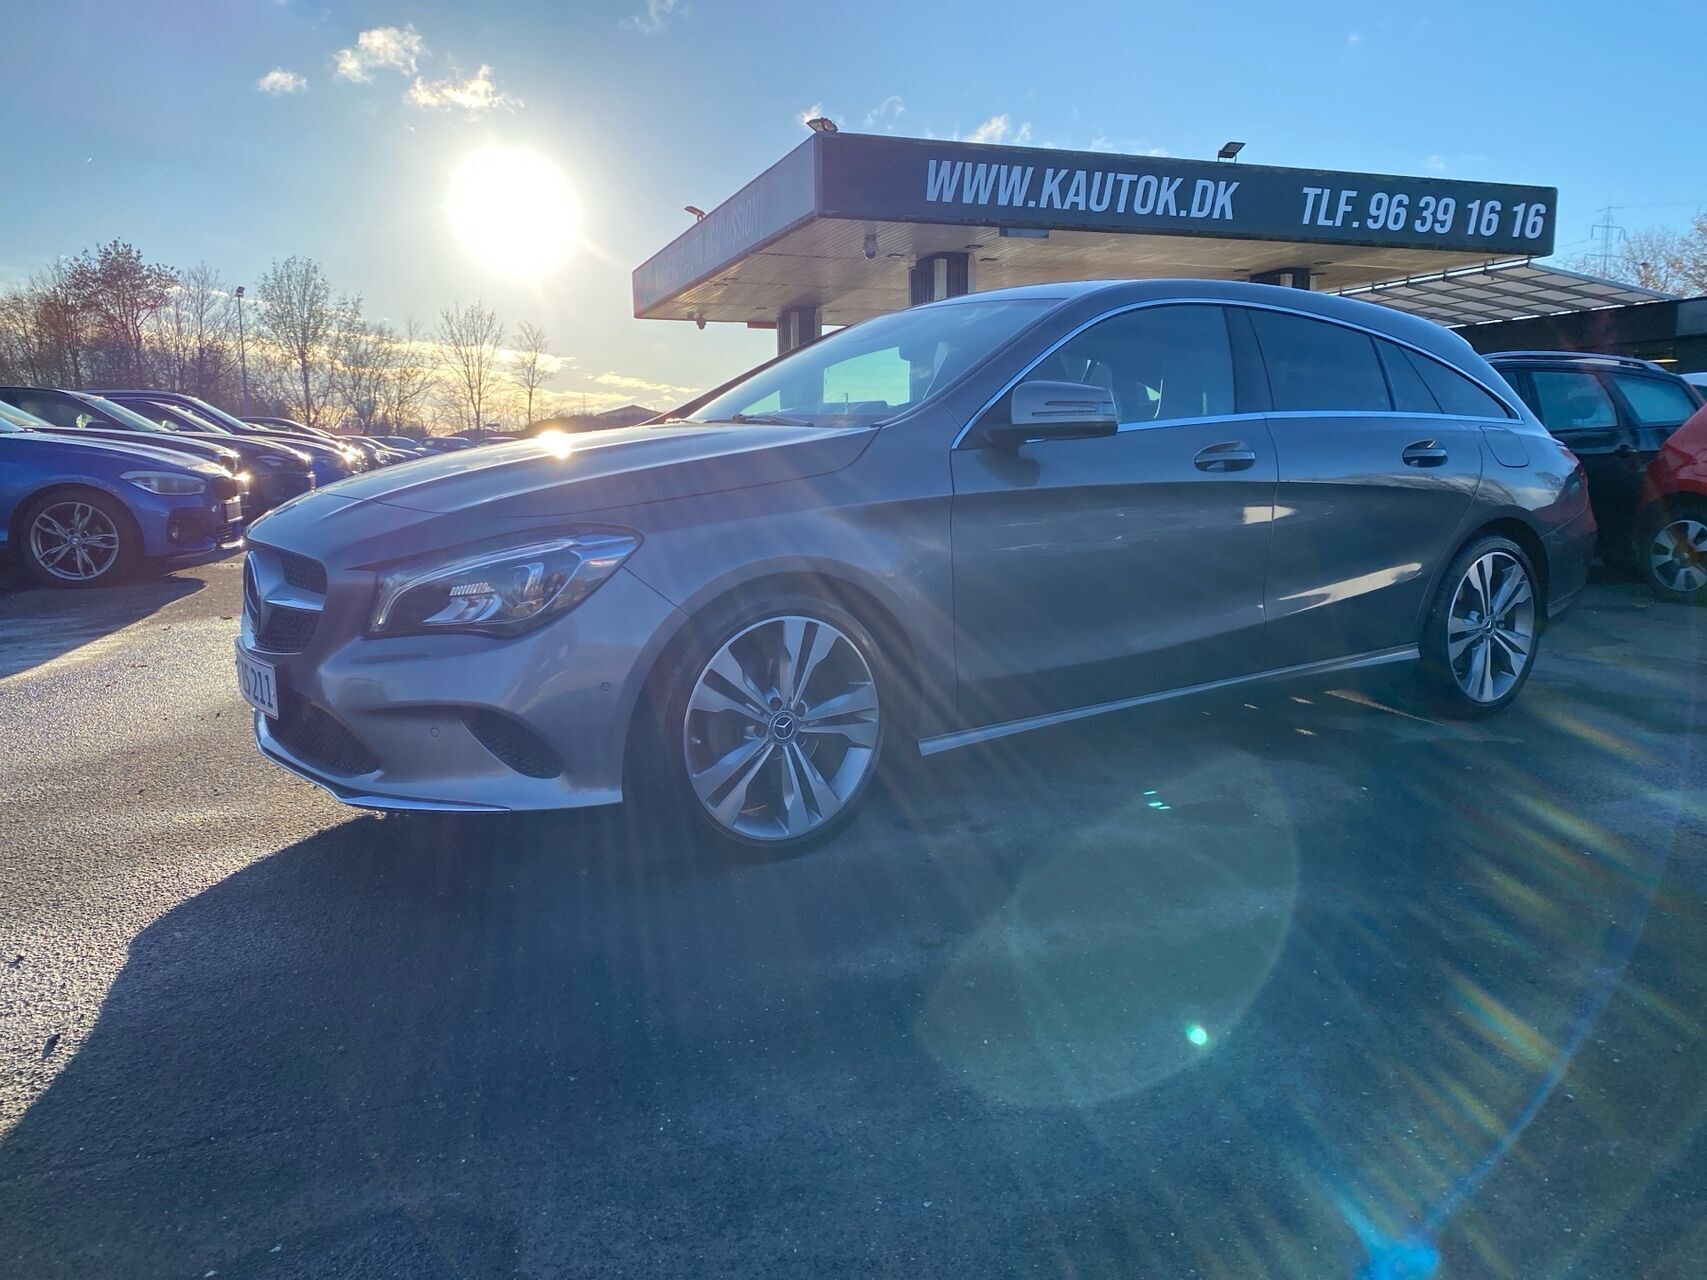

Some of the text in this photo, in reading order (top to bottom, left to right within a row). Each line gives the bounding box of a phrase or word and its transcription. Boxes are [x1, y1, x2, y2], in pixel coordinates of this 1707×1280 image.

[926, 159, 1240, 220] WWW.KAUTOK.DK
[1302, 187, 1547, 240] TLF. 96 39 16 16
